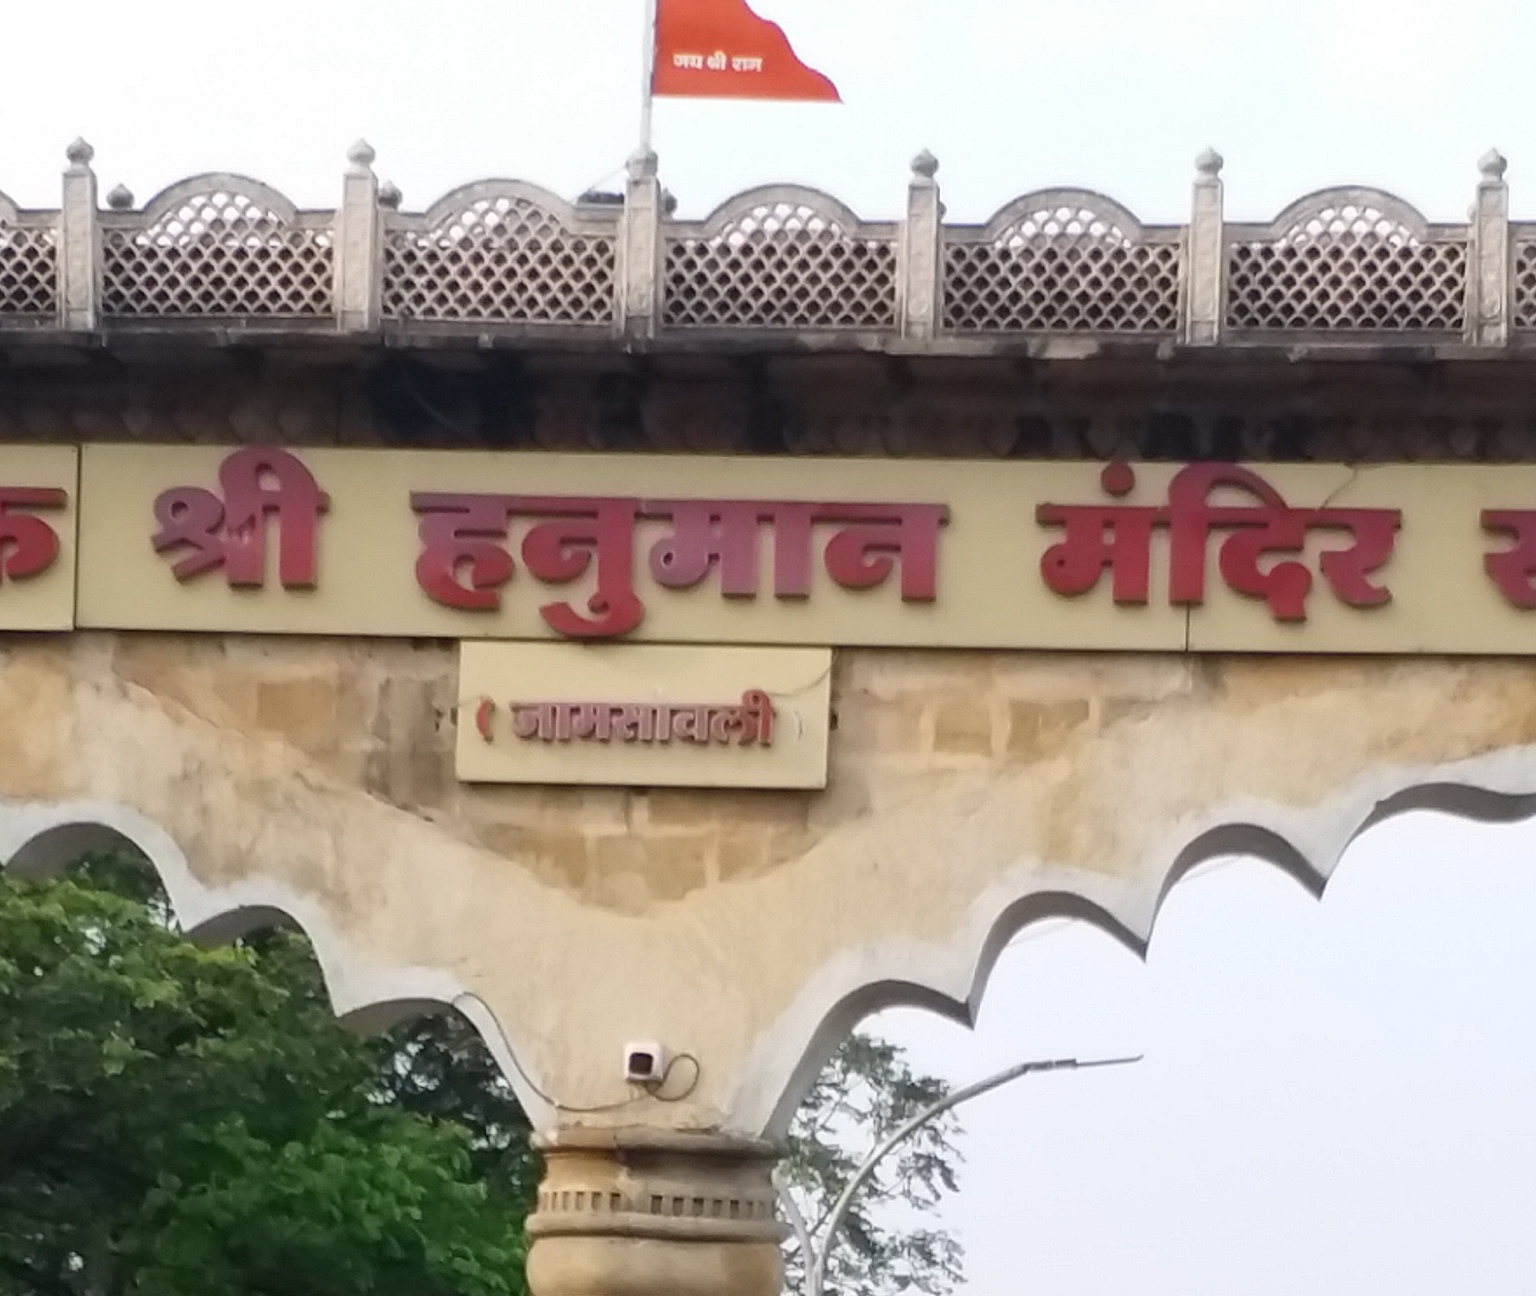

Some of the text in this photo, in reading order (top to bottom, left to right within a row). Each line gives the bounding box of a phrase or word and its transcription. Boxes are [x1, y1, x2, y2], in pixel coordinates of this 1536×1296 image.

[673, 50, 763, 72] जय श्री राम
[151, 446, 331, 592] श्री
[410, 490, 951, 637] हनुमान
[1036, 460, 1402, 624] मंदिर
